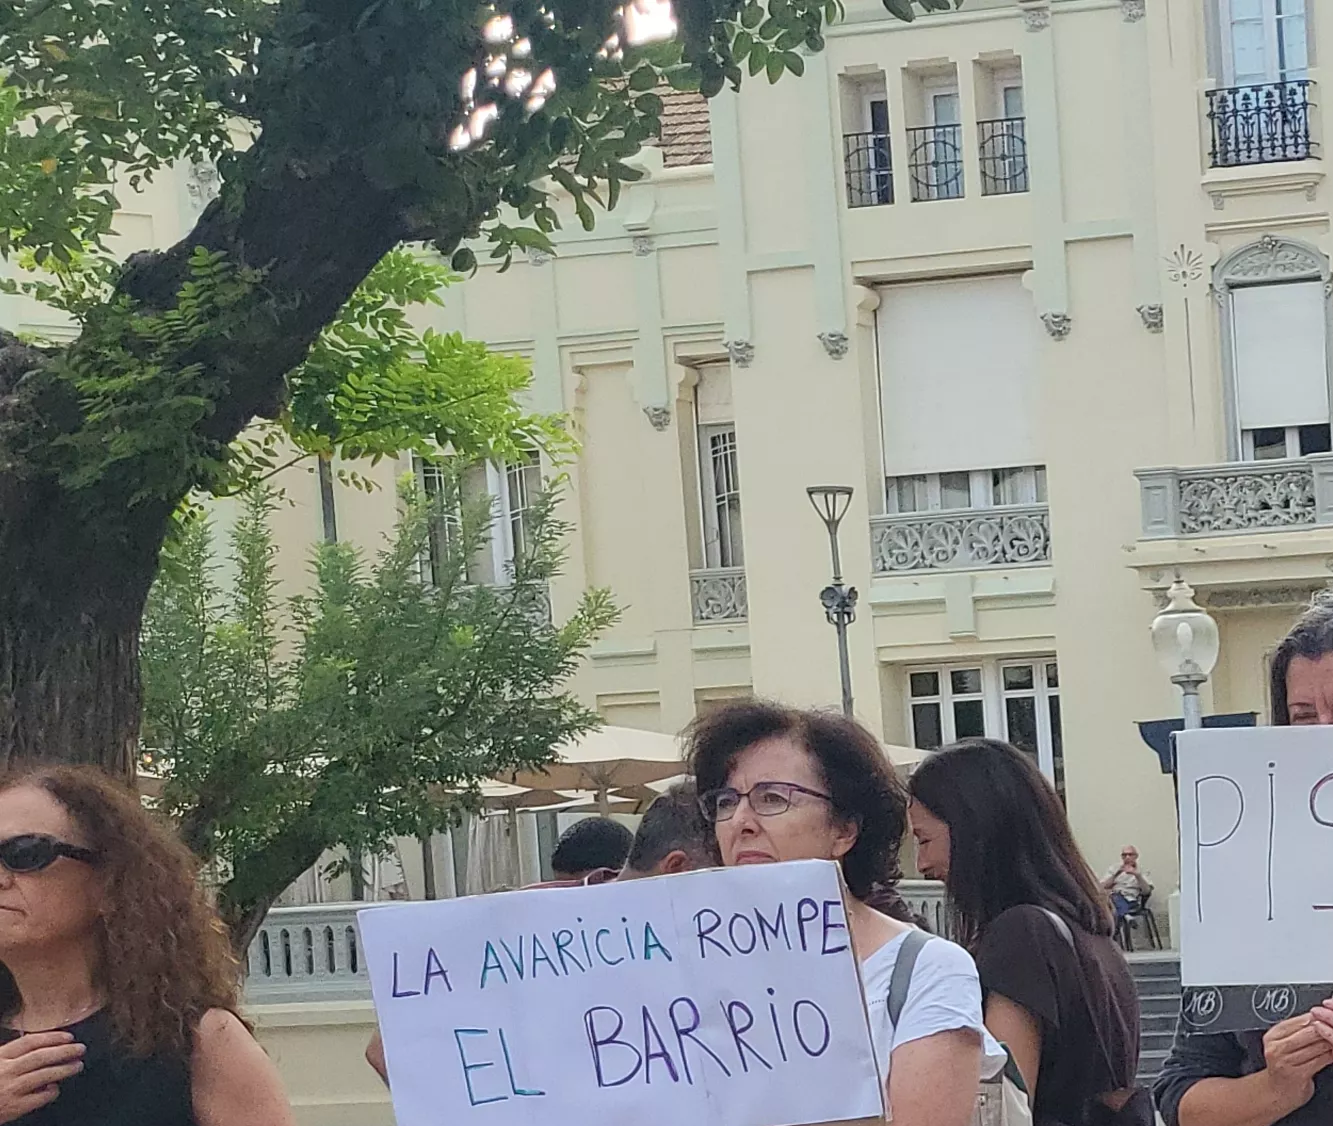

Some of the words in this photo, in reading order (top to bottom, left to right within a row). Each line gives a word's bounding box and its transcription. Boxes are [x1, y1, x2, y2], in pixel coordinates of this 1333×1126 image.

[392, 947, 453, 998] LA
[692, 897, 849, 959] ROMPE
[454, 1028, 546, 1106] EL
